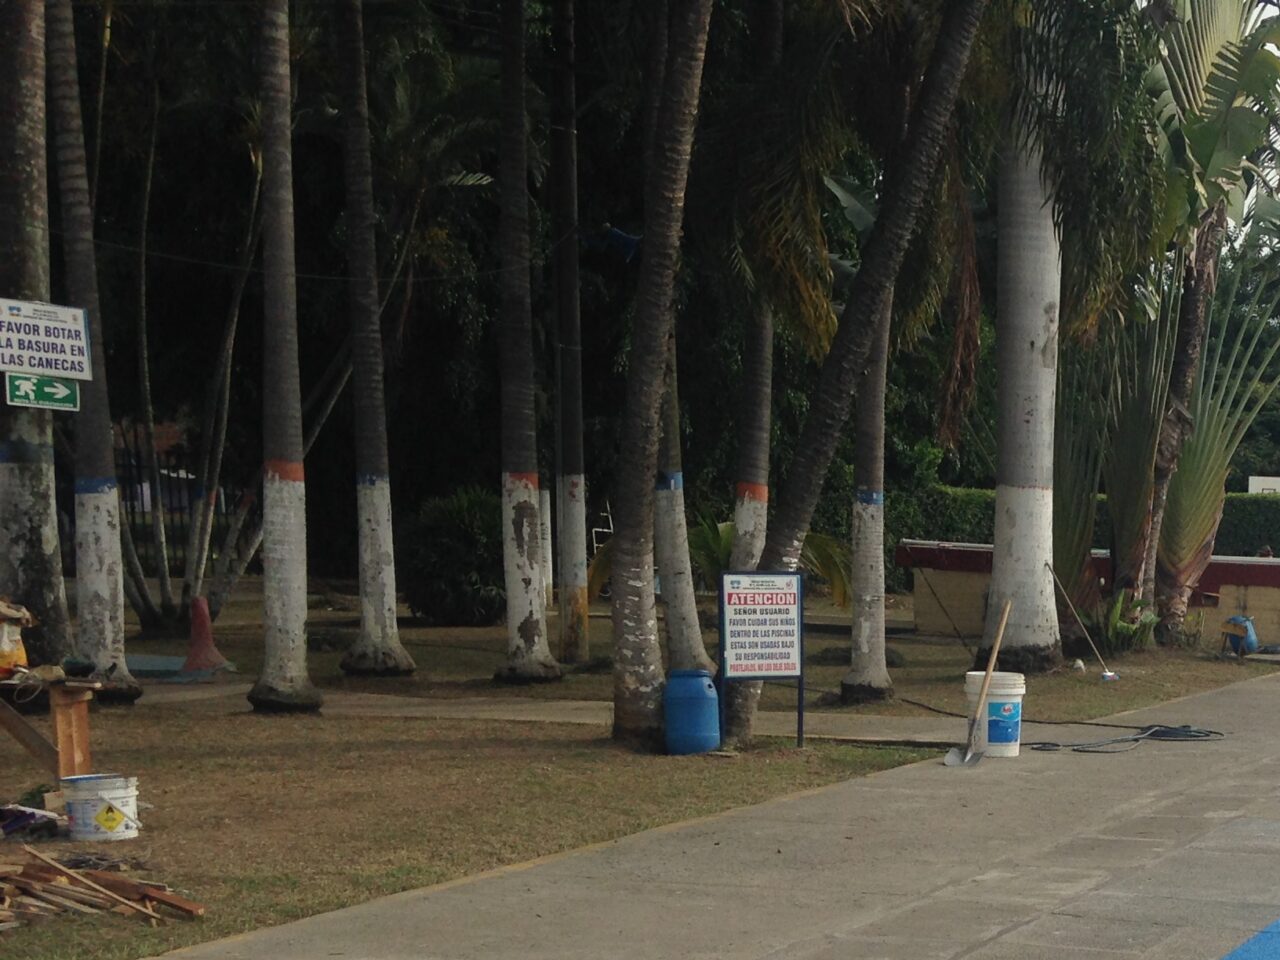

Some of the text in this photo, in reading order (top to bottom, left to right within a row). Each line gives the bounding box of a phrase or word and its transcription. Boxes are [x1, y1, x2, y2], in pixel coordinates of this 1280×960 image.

[0, 321, 82, 340] FAVOR BOTAR
[18, 339, 67, 355] BASURA
[70, 344, 85, 357] EN
[1, 353, 84, 372] LAS CANECAS
[730, 594, 795, 605] ATENCION
[733, 607, 757, 615] SEÑOR
[729, 618, 746, 626] FAVOR
[748, 618, 767, 626] CUIDAR
[730, 630, 751, 638] DENTRO
[760, 629, 770, 637] LAS
[771, 629, 795, 637] PISCINAS
[730, 641, 746, 649] ESTAS
[748, 641, 759, 649] SON
[781, 640, 795, 648] BAJO
[743, 652, 791, 660] RESPONSABILIDAD
